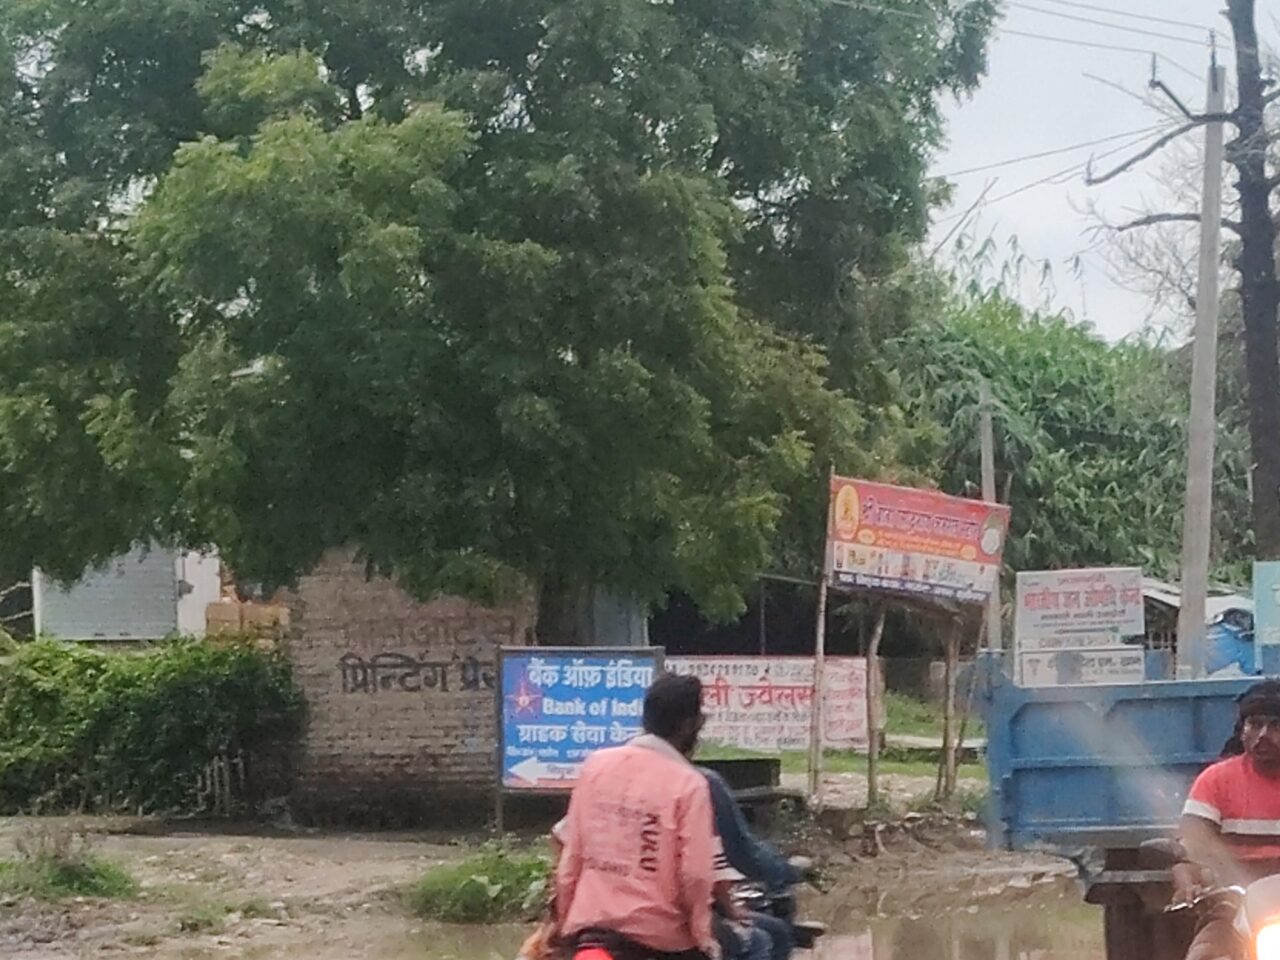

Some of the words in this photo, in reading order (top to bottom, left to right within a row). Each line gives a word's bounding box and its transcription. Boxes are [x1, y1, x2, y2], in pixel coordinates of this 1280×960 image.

[527, 657, 560, 688] बैंक
[602, 659, 654, 689] इंडिया
[542, 698, 586, 716] Bank
[588, 697, 608, 716] of
[611, 697, 645, 717] Indi
[516, 723, 568, 744] ग्राहक
[570, 721, 607, 745] सेवा
